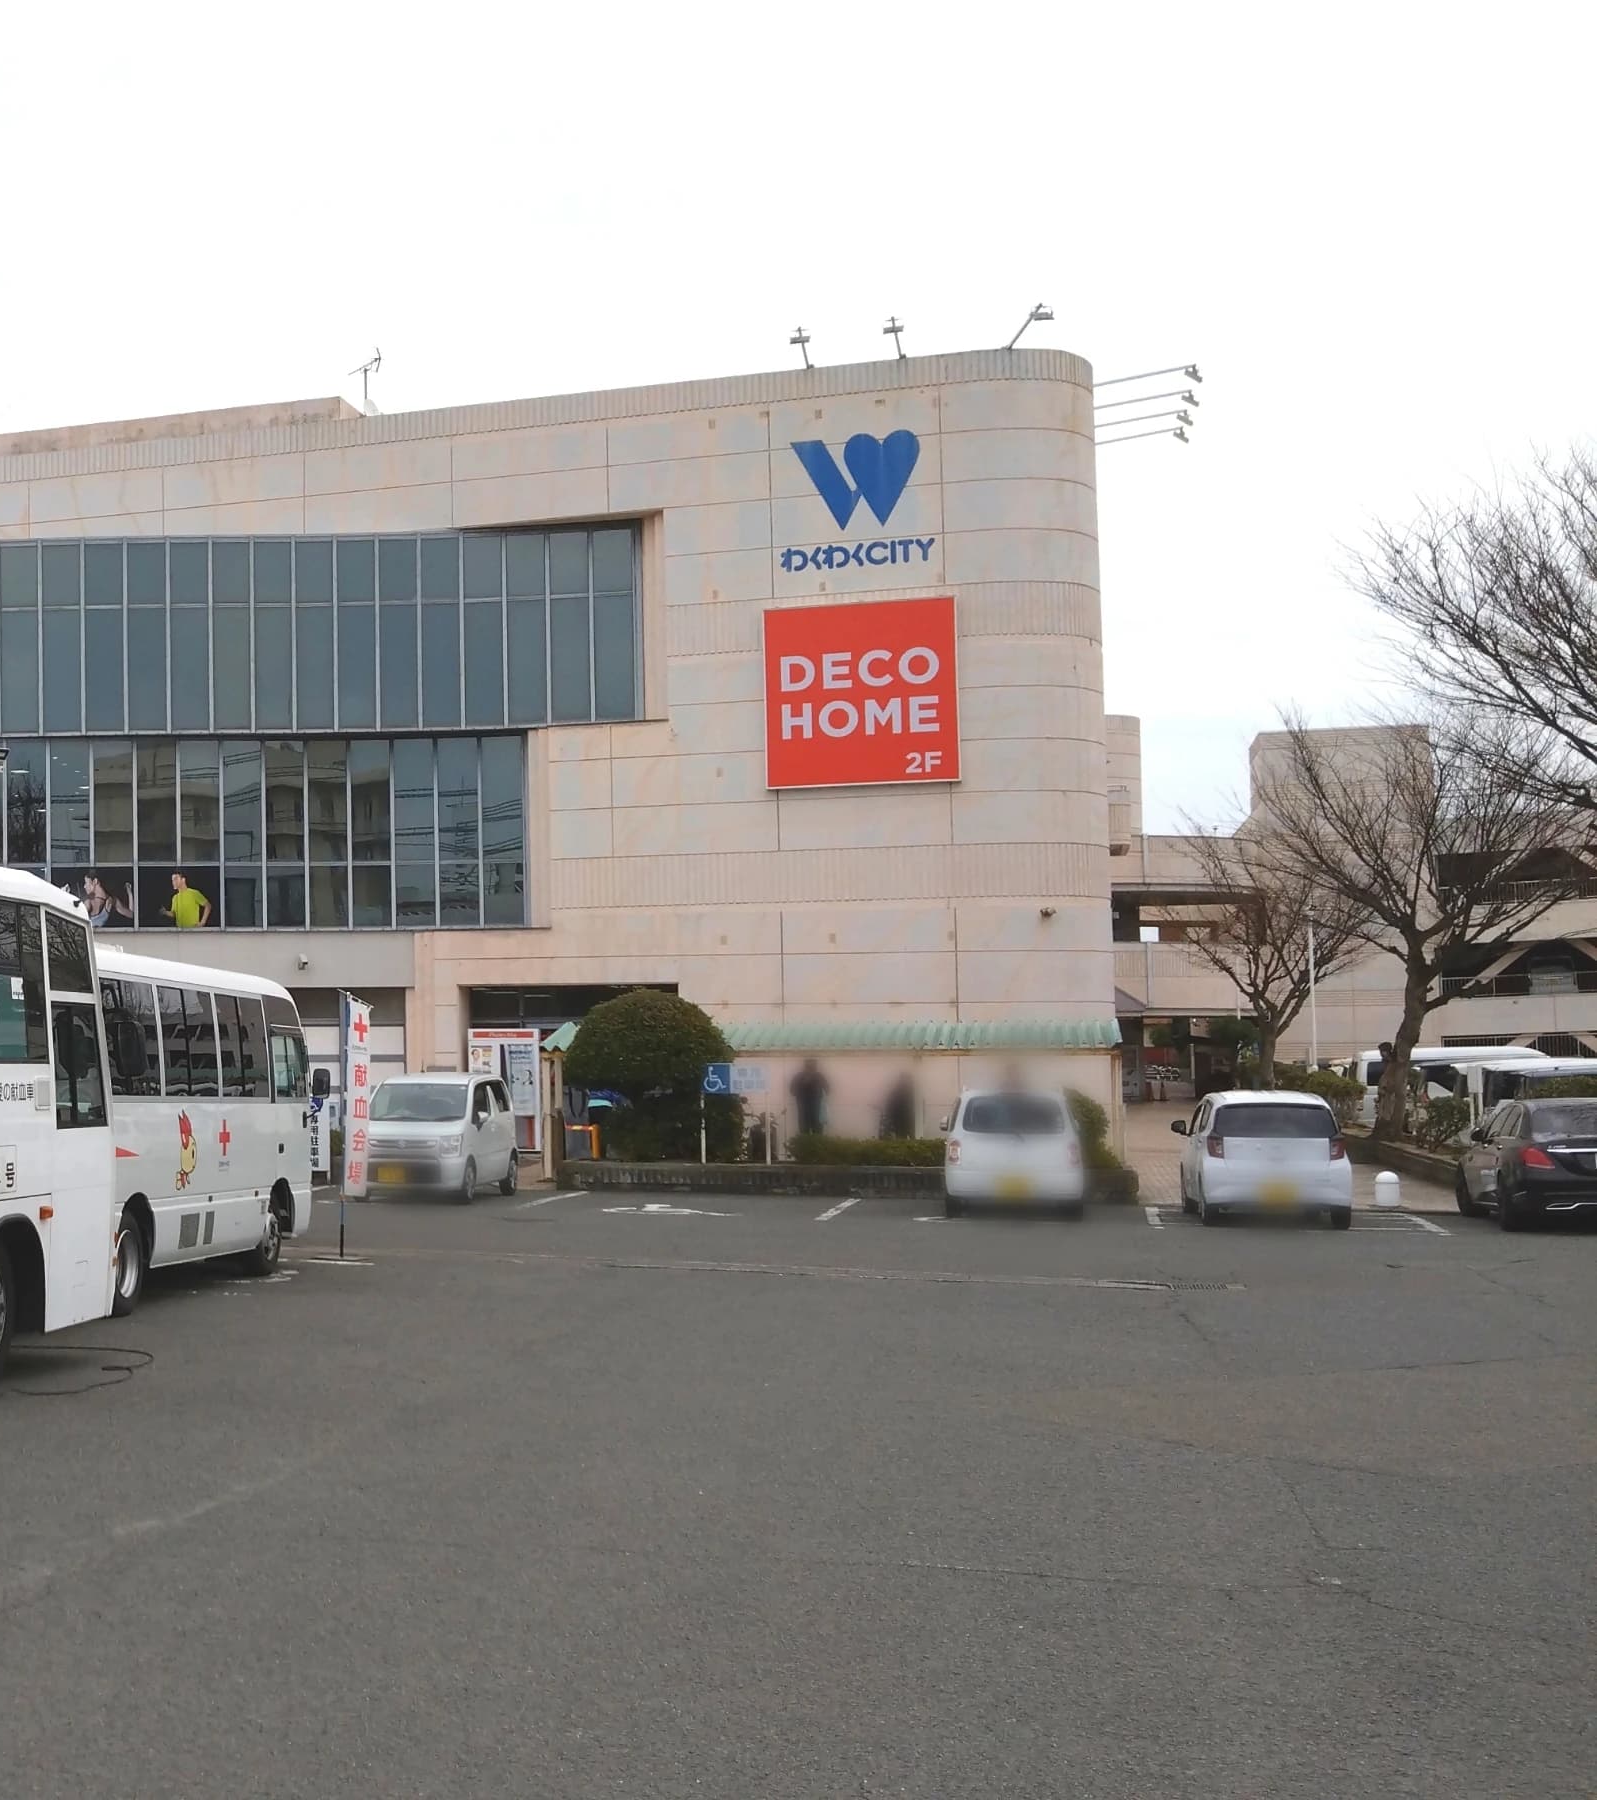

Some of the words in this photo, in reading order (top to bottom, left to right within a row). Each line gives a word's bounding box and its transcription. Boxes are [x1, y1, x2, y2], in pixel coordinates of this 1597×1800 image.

[780, 537, 935, 573] わくわくCITY
[780, 646, 940, 692] DECO
[781, 695, 940, 740] HOME
[905, 751, 942, 774] 2F
[347, 1063, 368, 1185] 献血会場
